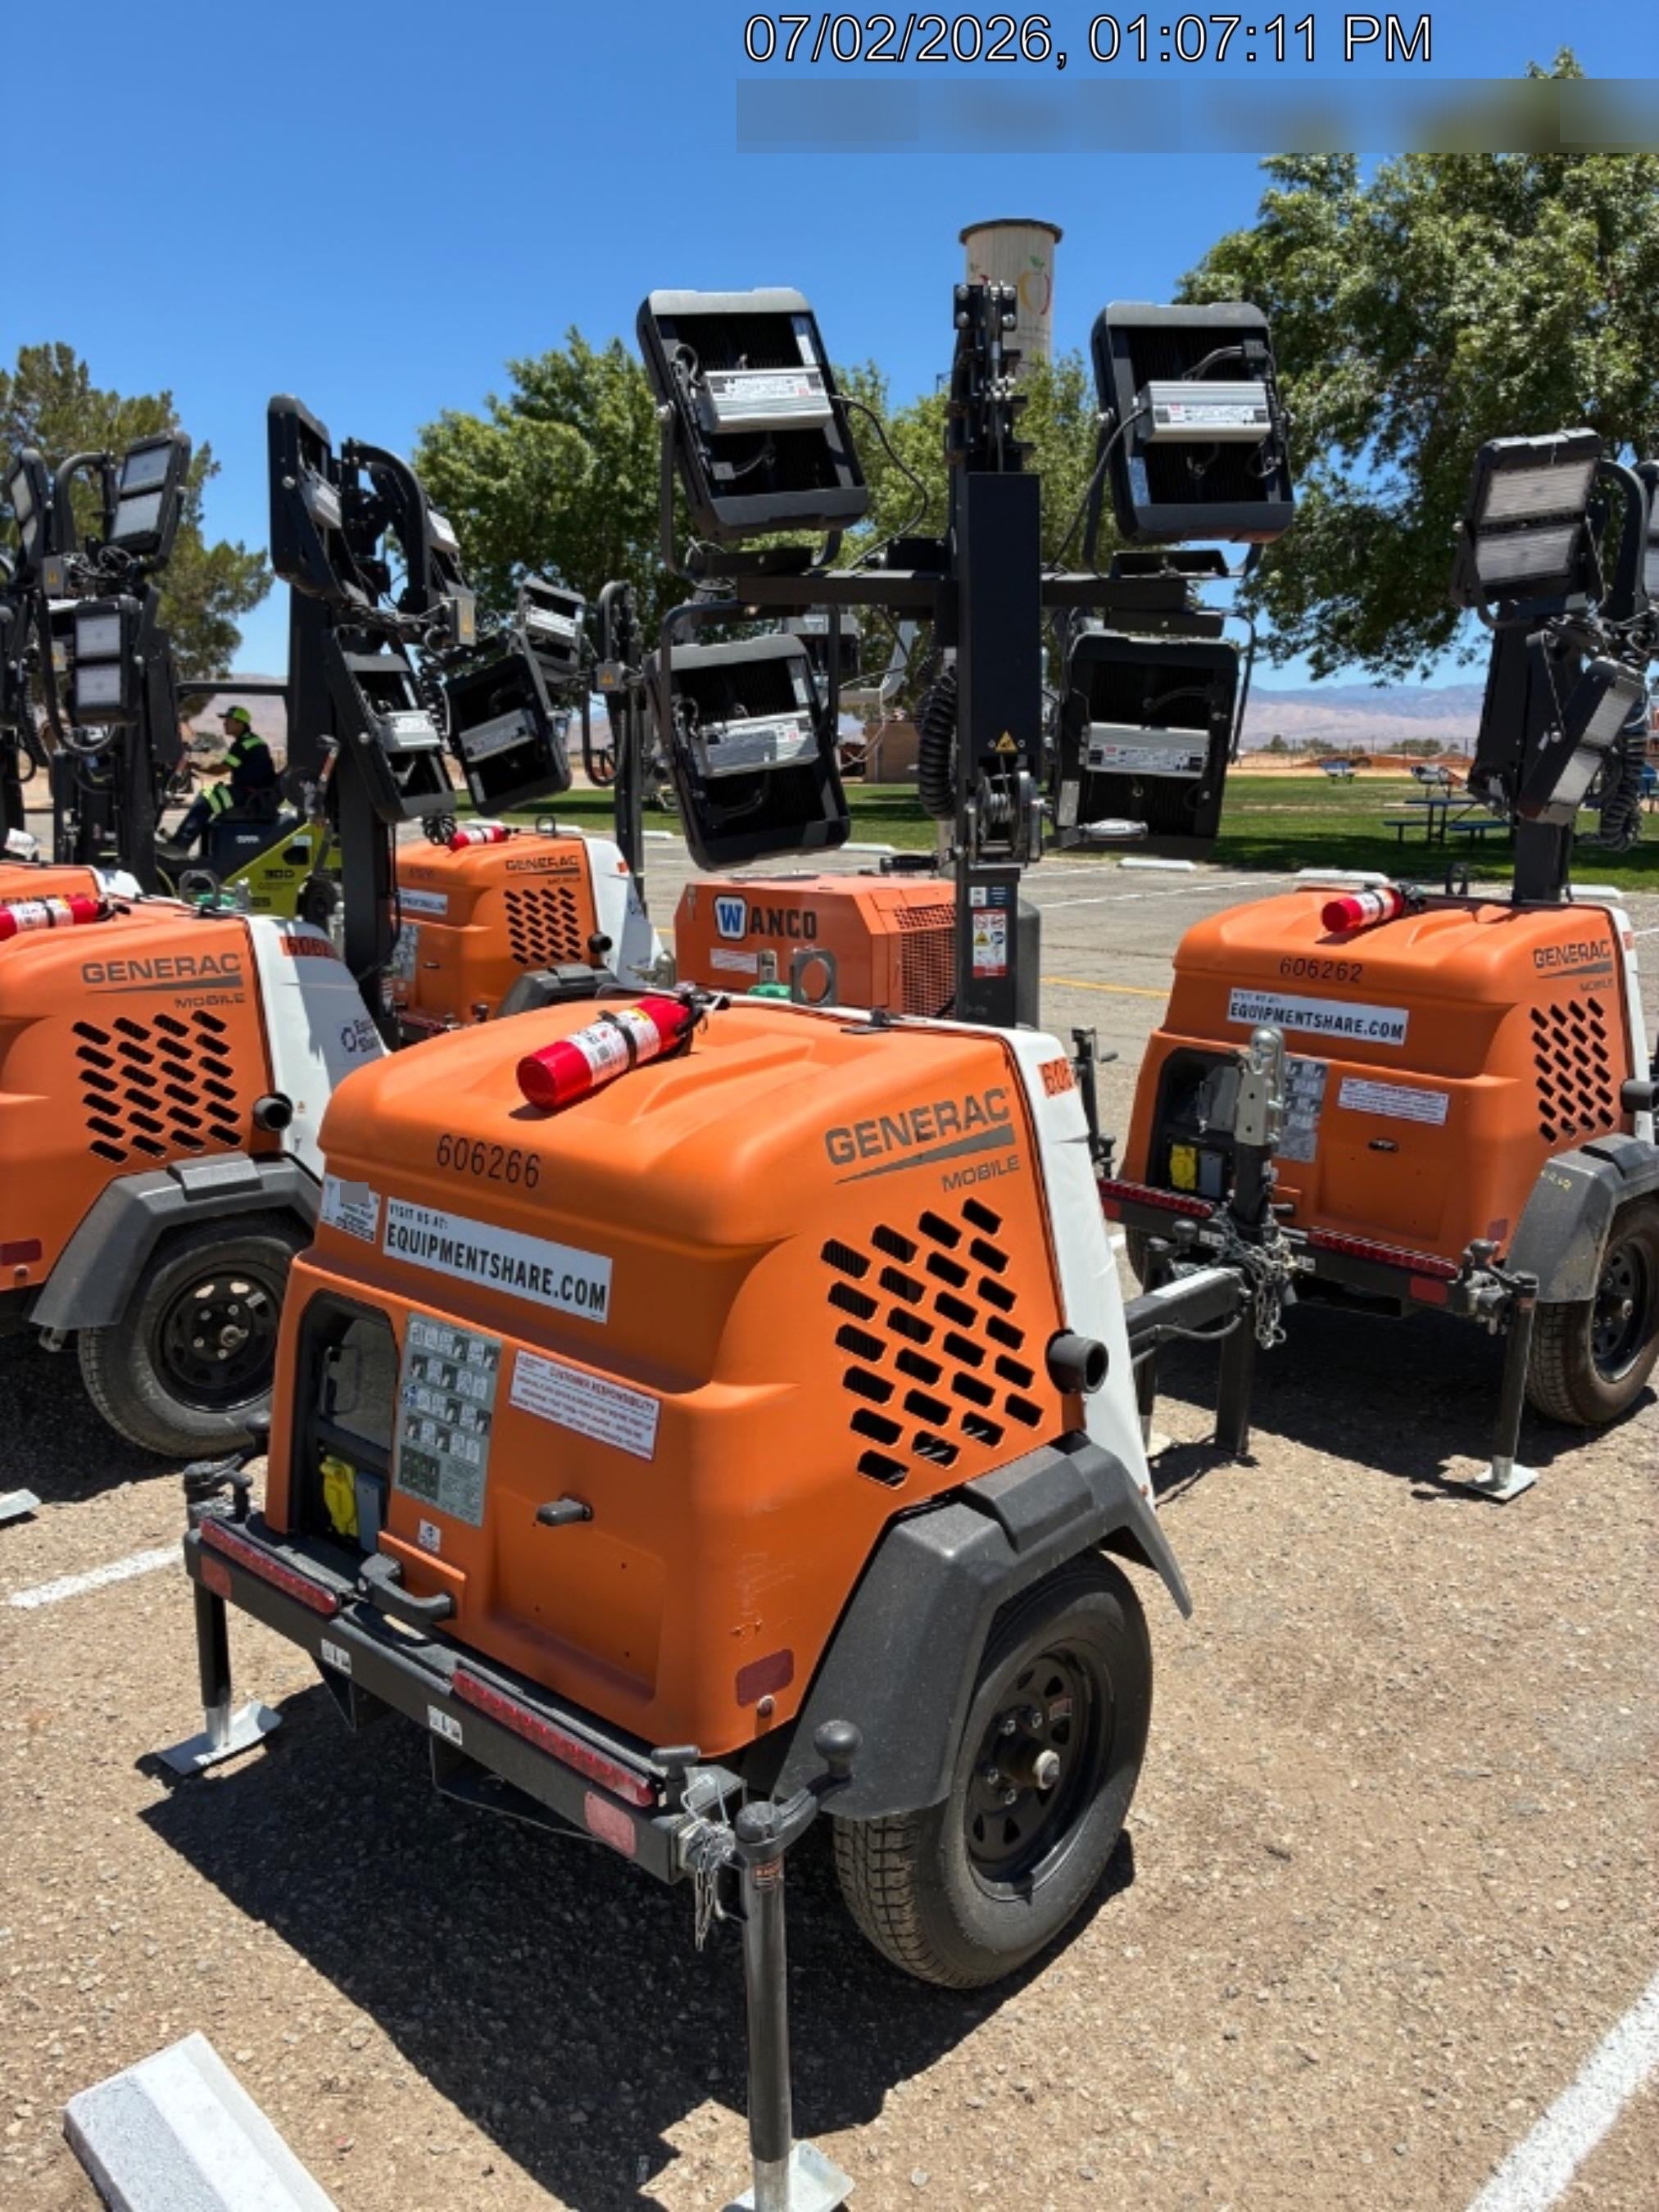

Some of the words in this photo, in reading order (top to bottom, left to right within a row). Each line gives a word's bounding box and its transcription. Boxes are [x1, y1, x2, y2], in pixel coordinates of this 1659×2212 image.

[718, 901, 817, 940] WANCO
[81, 953, 241, 984] GENERAC
[1280, 957, 1362, 983] 606262
[1534, 939, 1611, 968] GENERAC
[175, 992, 245, 1009] MOBILE
[1231, 1002, 1404, 1040] EQUIPMENTSHARE.COM
[825, 1087, 1009, 1166] GENERAC
[437, 1134, 542, 1189] 606266
[942, 1154, 1021, 1193] MOBILE
[388, 1223, 606, 1312] EQUIPMENTSHARE.COM
